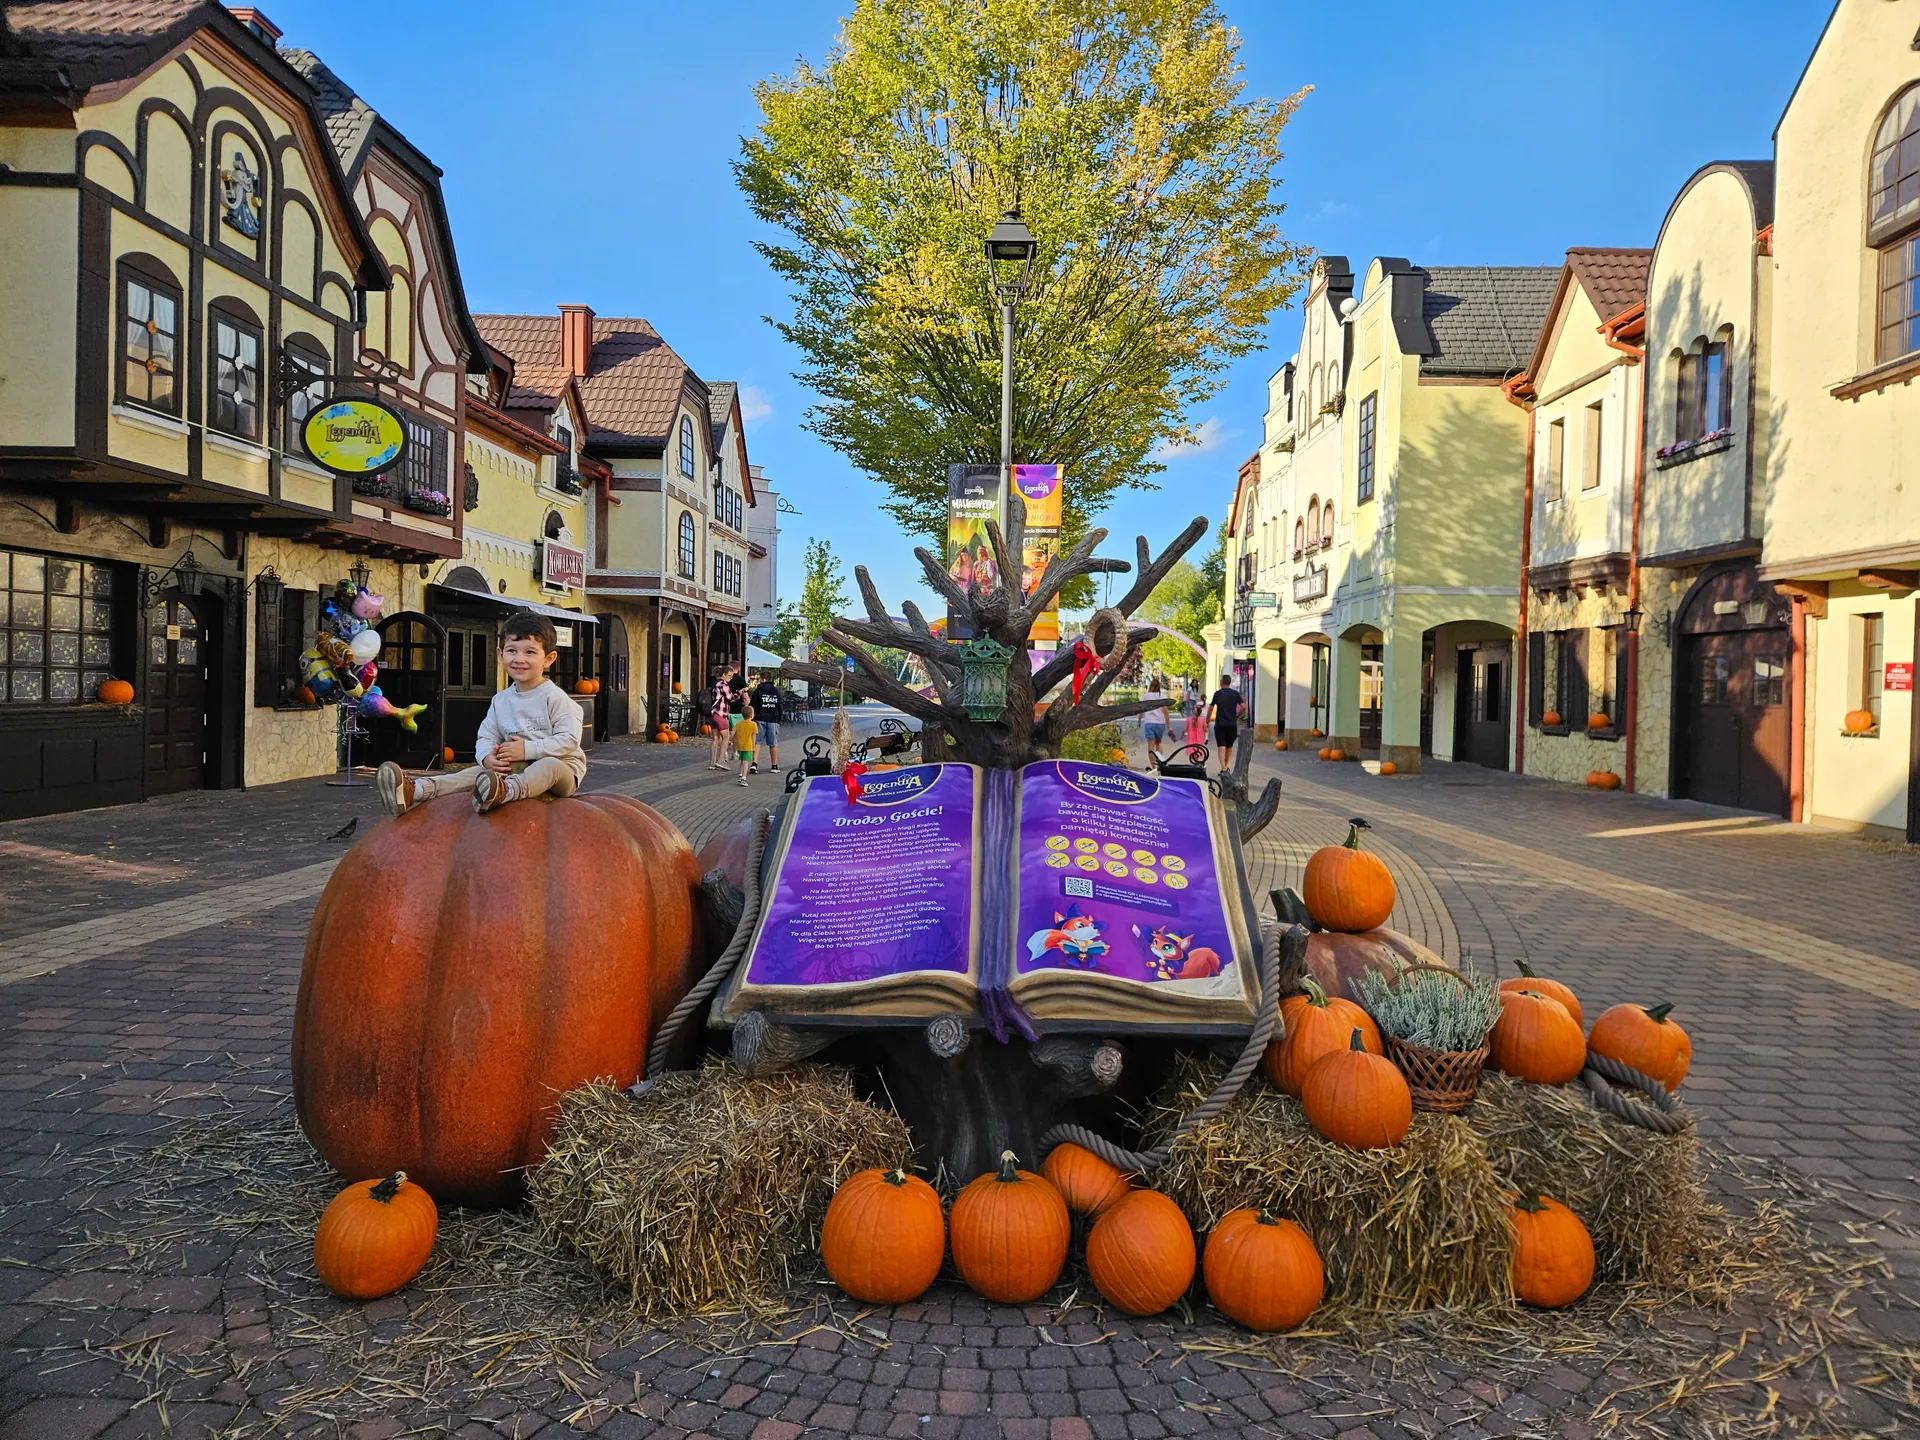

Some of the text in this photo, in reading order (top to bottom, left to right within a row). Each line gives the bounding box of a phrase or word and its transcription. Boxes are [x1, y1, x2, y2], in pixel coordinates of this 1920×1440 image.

[832, 806, 943, 827] Drodzy Goście!
[1058, 808, 1169, 834] bawić się bezpiecznie
[1076, 803, 1128, 817] zachować
[1129, 813, 1166, 826] radość,
[1060, 824, 1169, 849] pamiętaj koniecznie!
[1081, 818, 1106, 828] kilku
[1108, 824, 1157, 839] zasadach
